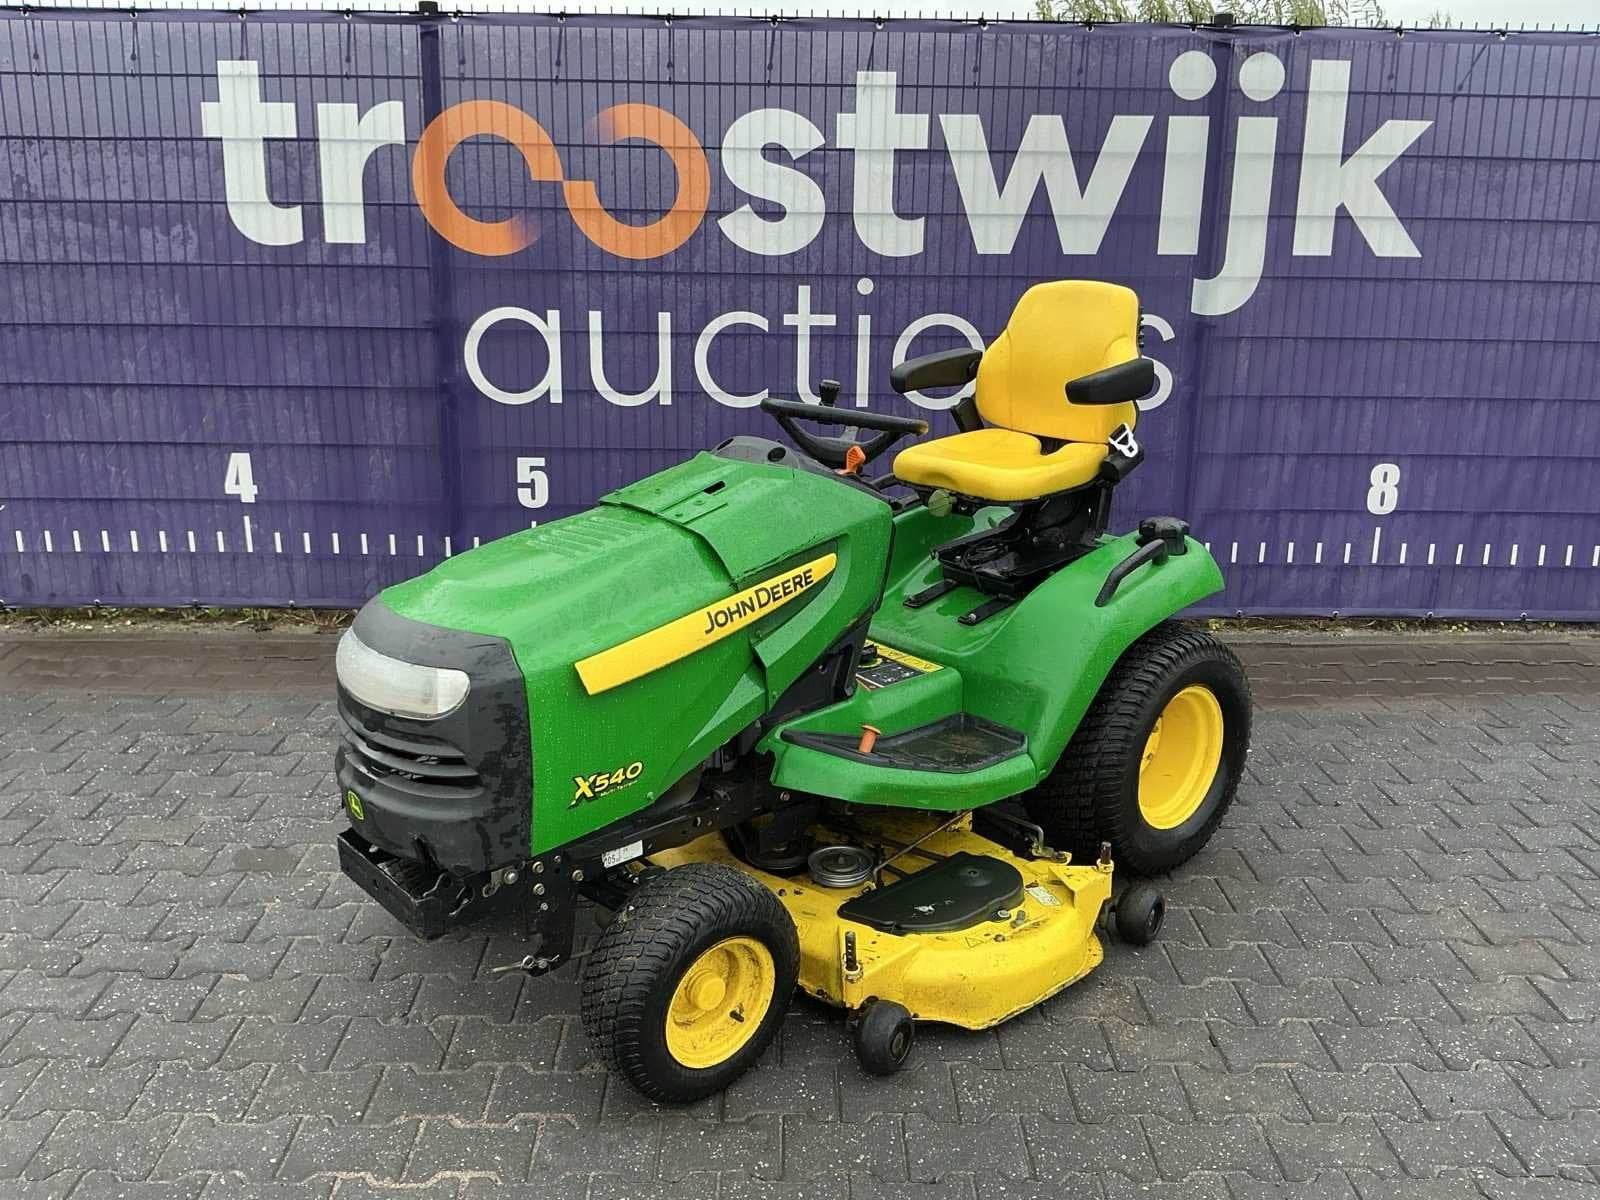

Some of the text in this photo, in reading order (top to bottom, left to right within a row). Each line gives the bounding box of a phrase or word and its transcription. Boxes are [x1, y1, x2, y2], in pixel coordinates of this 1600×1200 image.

[201, 51, 1433, 316] troostwijk
[464, 277, 1175, 411] auctios
[224, 452, 258, 503] 4
[517, 457, 549, 509] 5
[1367, 463, 1400, 515] 8
[704, 568, 815, 635] JOHN DEERE
[568, 760, 643, 809] X540
